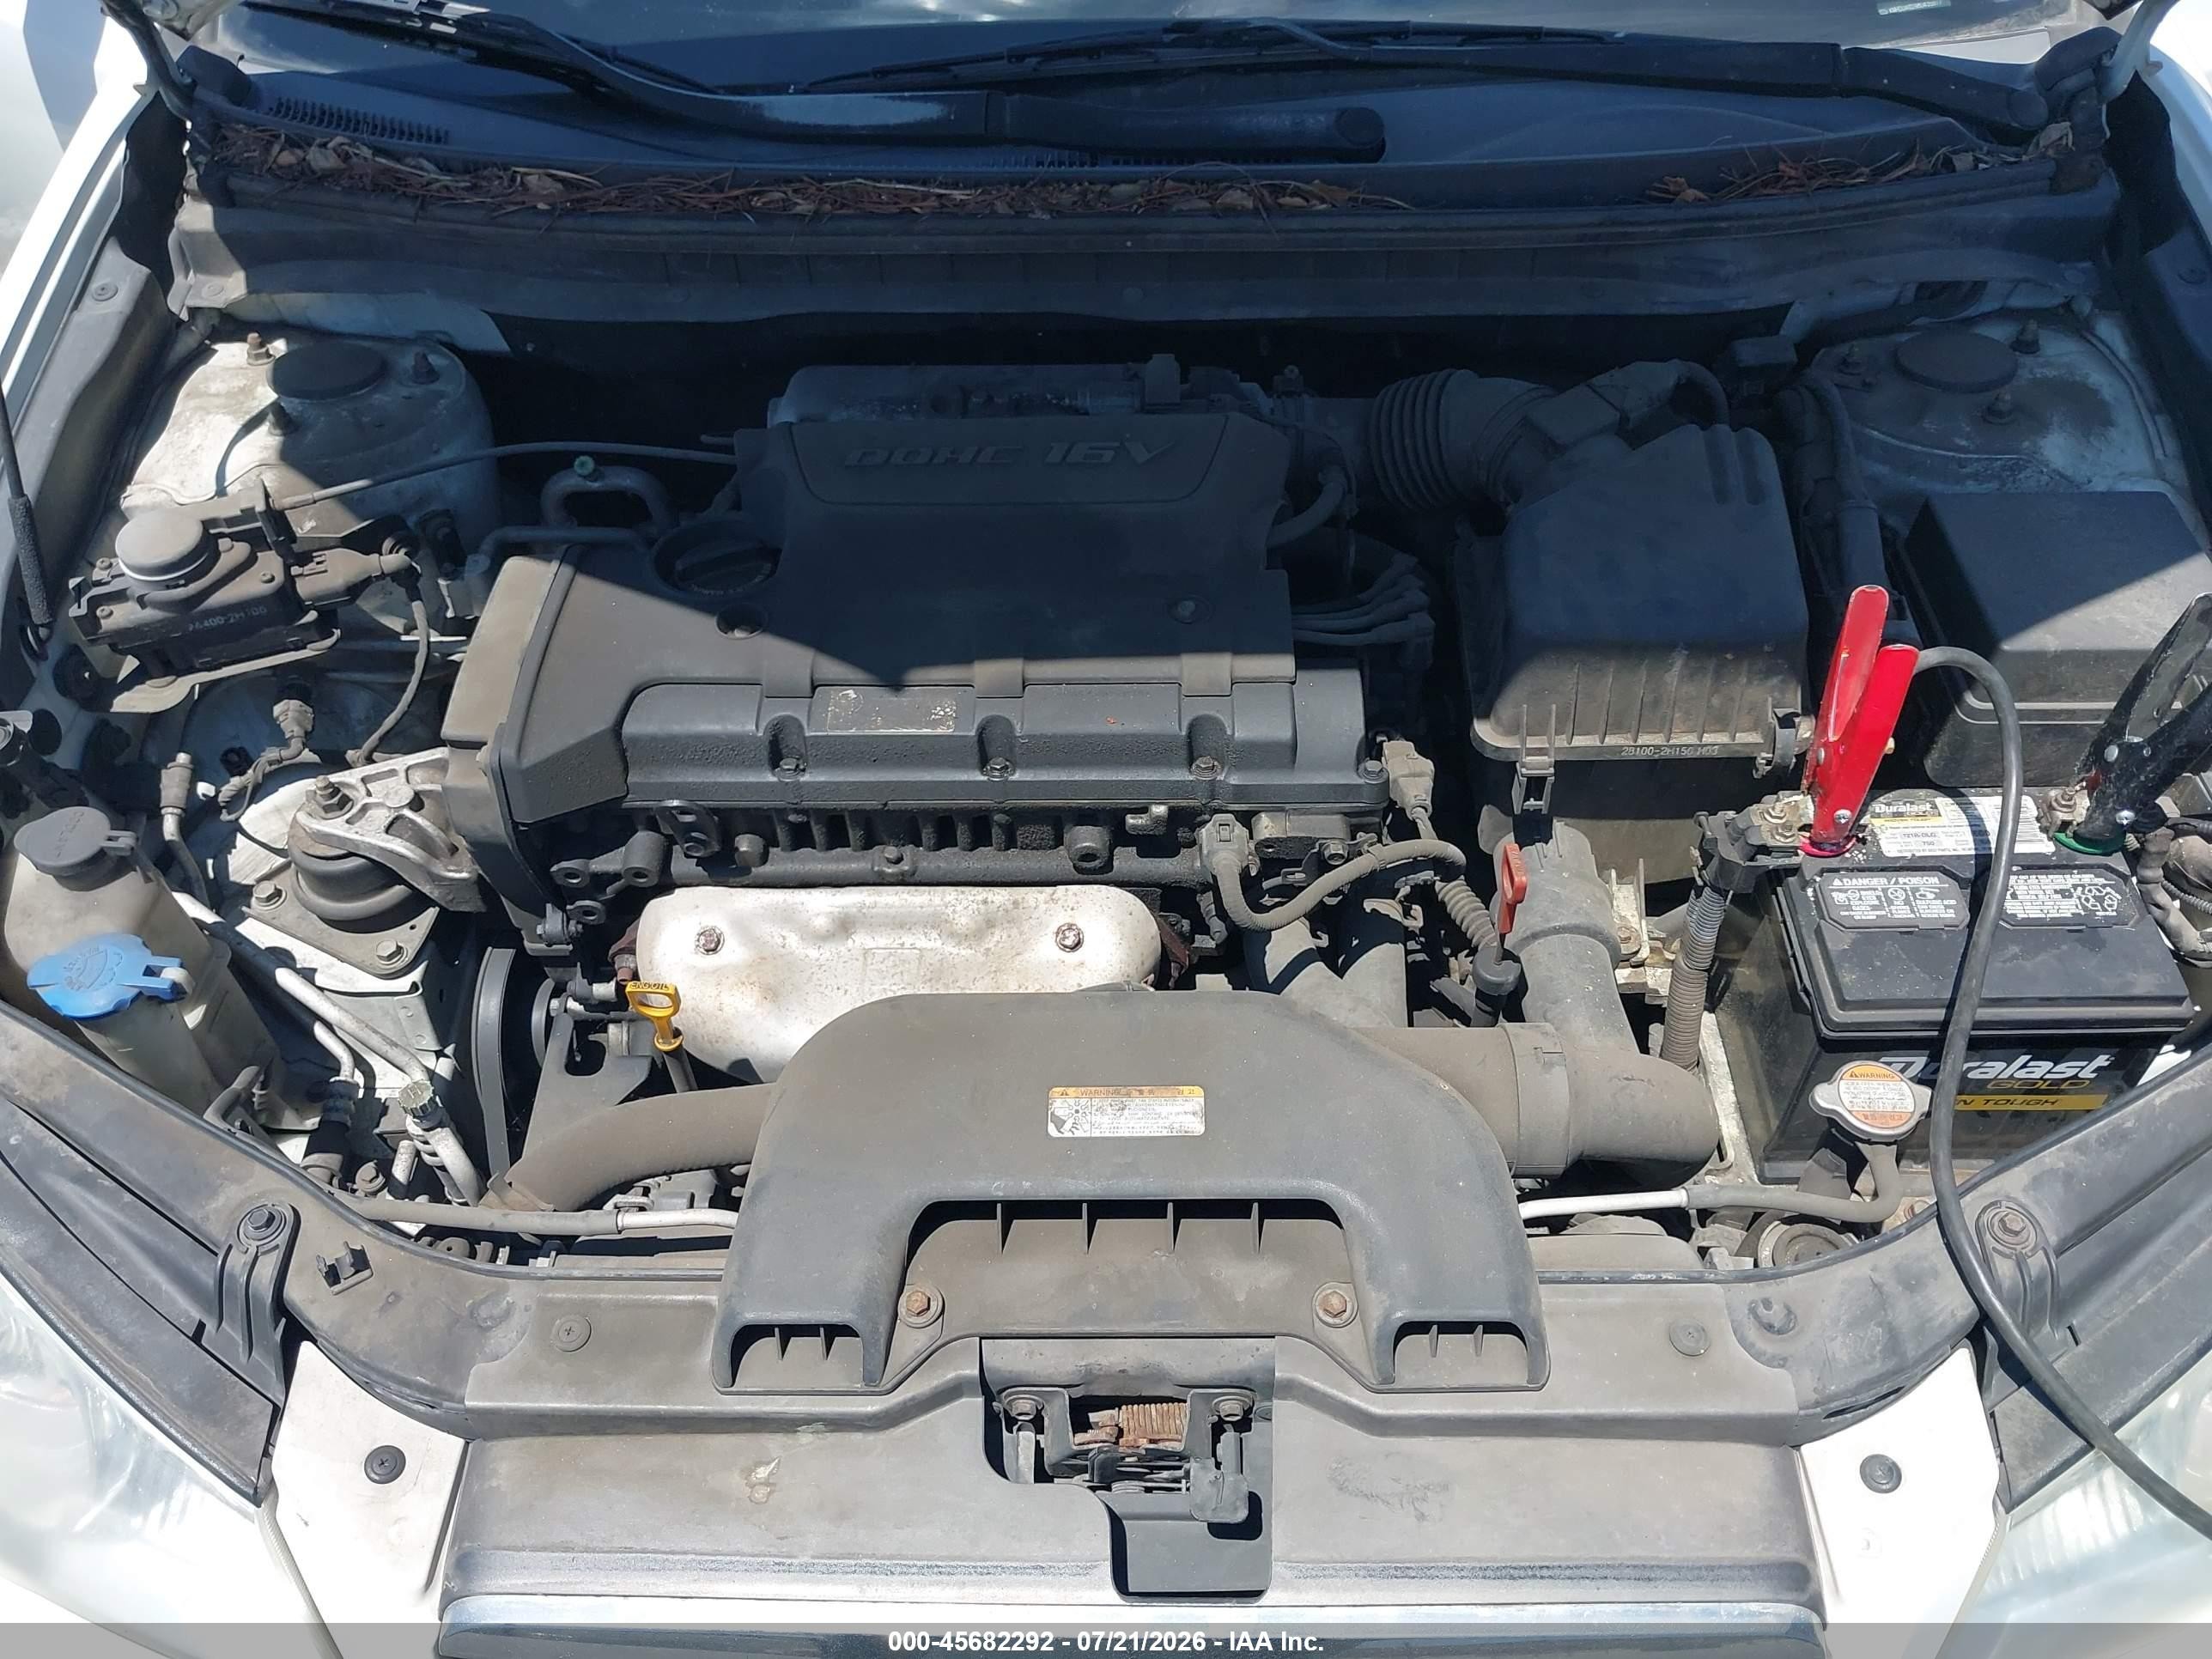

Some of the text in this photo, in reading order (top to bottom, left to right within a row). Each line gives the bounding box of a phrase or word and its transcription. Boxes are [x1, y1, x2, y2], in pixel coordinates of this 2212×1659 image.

[844, 441, 1176, 466] DOHC 16V
[1872, 802, 1933, 813] Duralast
[1986, 1079, 2091, 1090] GOLD
[1982, 1098, 2060, 1107] TOUGH
